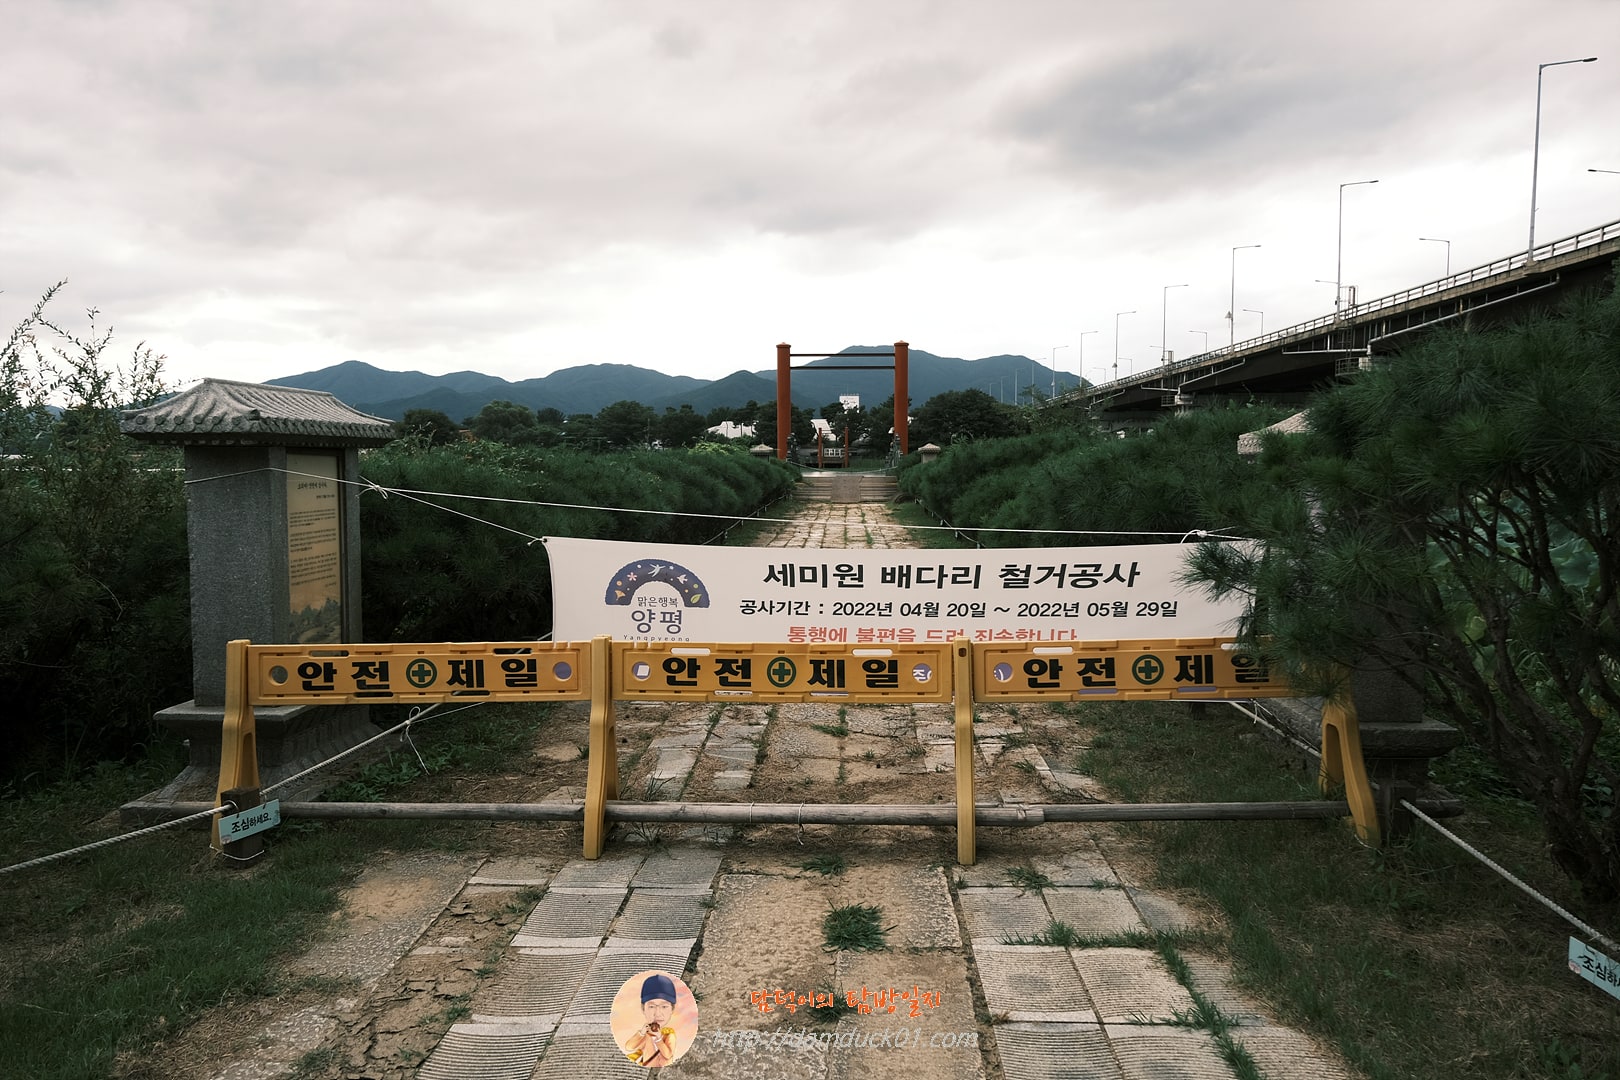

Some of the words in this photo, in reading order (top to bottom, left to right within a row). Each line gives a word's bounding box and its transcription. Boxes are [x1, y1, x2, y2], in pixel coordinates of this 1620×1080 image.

[763, 563, 865, 588] 세미원
[880, 564, 982, 589] 배다리
[998, 561, 1141, 589] 철거공사
[739, 600, 811, 616] 공사기간
[832, 601, 893, 617] 2022년
[900, 601, 940, 618] 04월
[946, 602, 986, 618] 20일
[1017, 602, 1080, 618] 2022년
[1087, 601, 1129, 618] 05월
[1135, 601, 1178, 618] 29일
[631, 608, 682, 635] 양평
[787, 626, 848, 643] 통행에
[856, 627, 917, 643] 불편을
